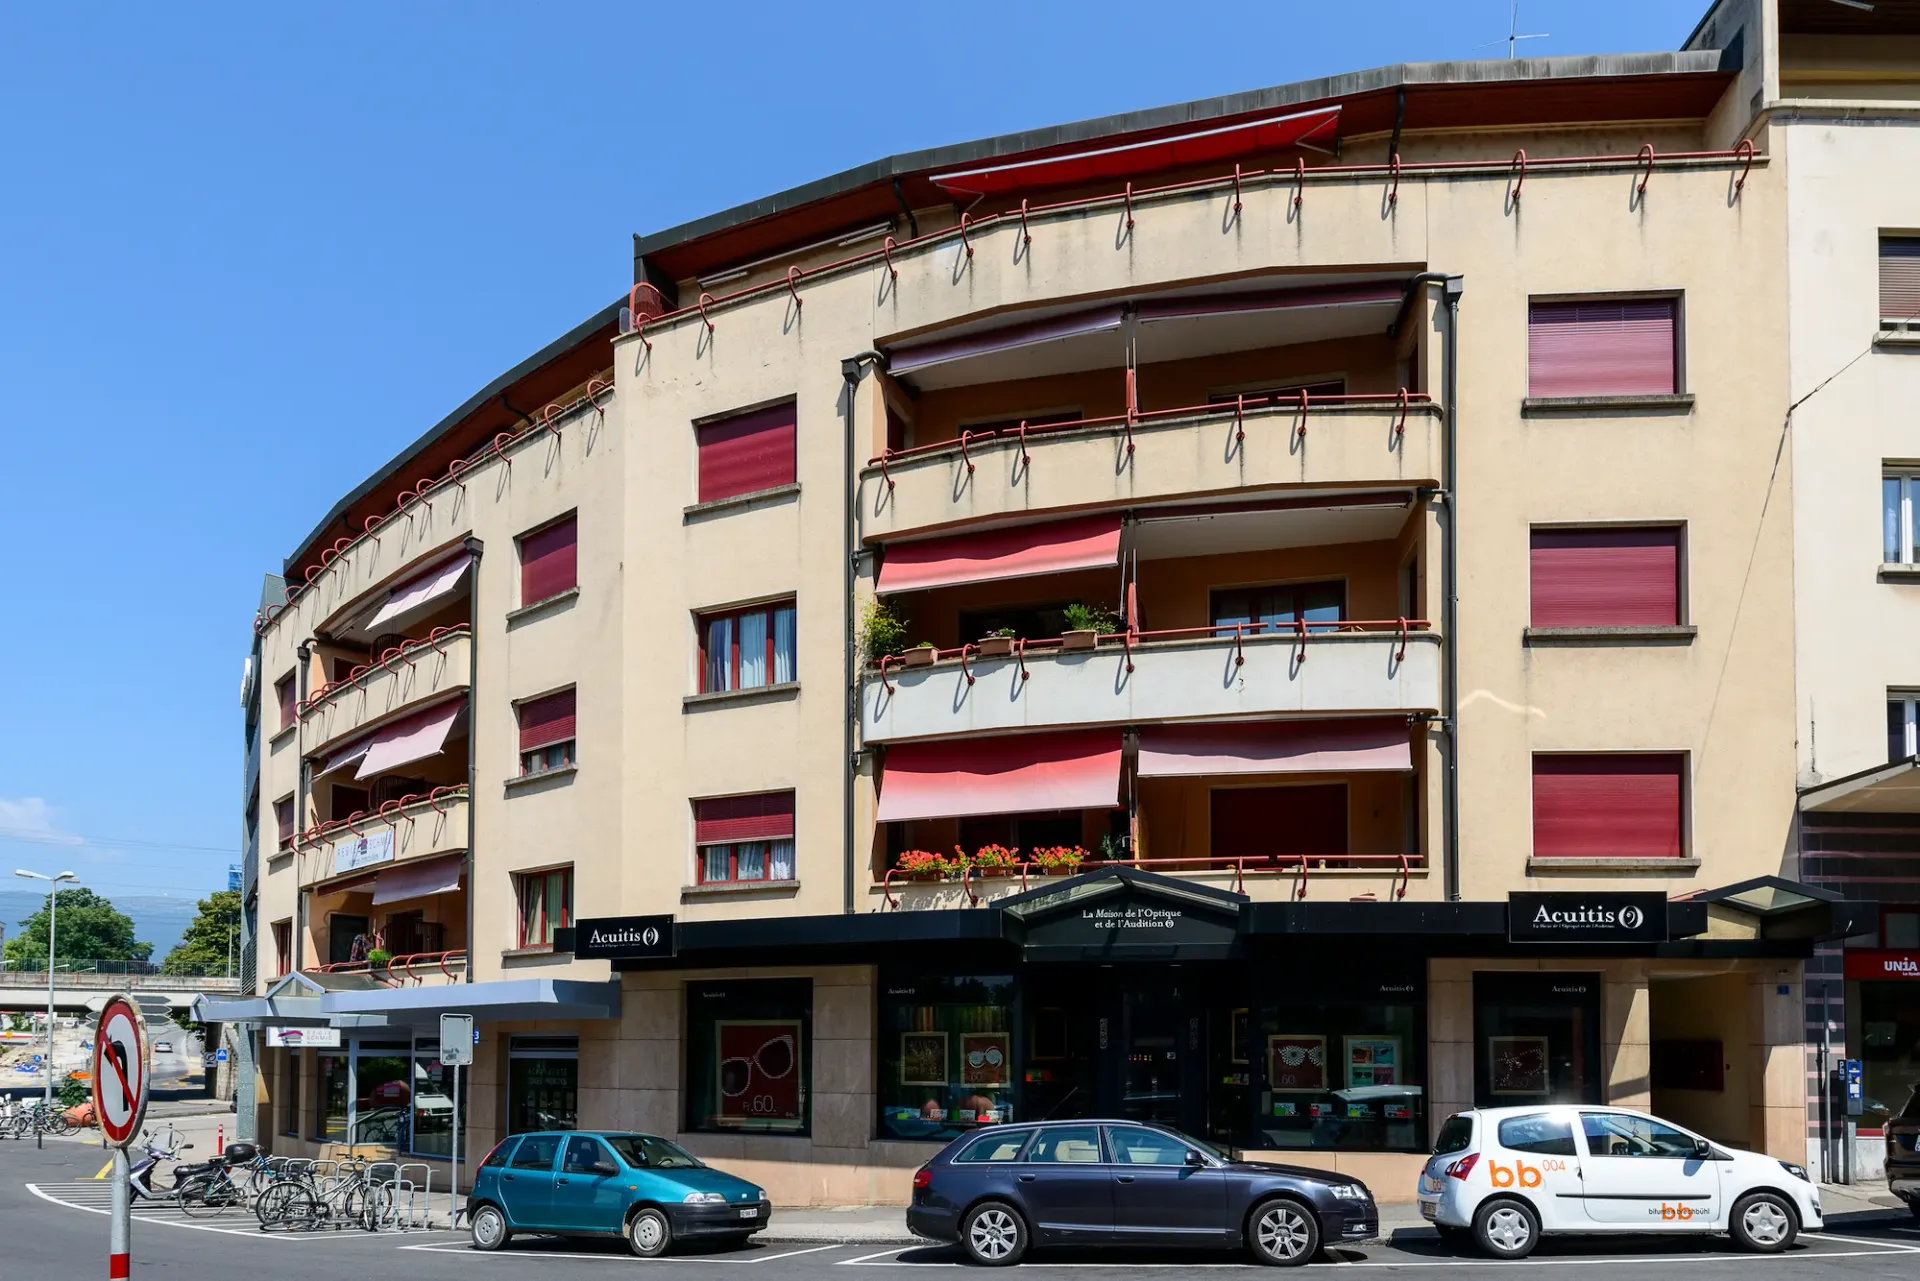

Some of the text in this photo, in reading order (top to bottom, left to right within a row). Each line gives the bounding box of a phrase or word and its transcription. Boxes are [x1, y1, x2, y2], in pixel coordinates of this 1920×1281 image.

[1082, 908, 1182, 920] La Maison de l'Optique
[1533, 904, 1615, 923] Acuitis
[1094, 919, 1164, 929] et de l'Audition
[589, 927, 641, 943] Acuitis
[1488, 1159, 1566, 1188] bb 004
[1661, 1202, 1693, 1220] bb
